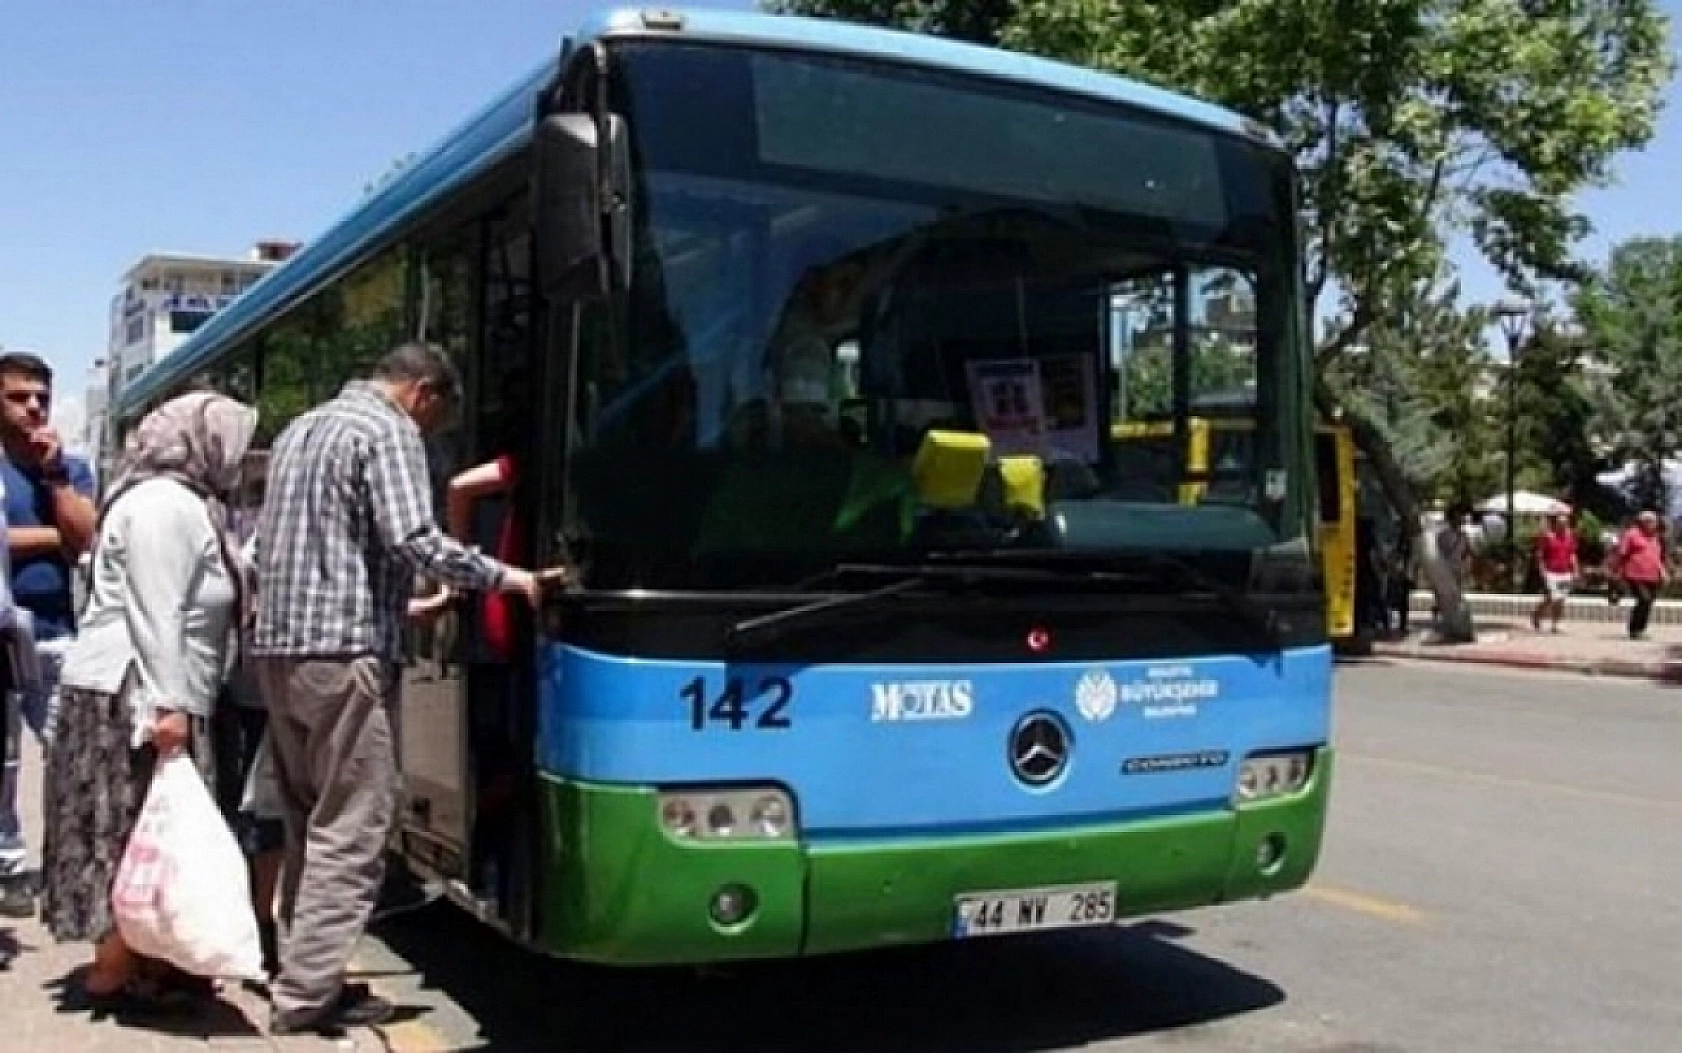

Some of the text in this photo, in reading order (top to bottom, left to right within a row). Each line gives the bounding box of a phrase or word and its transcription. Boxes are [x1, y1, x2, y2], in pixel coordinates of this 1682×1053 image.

[680, 675, 792, 730] 142
[974, 892, 1110, 928] 44 NV 285
